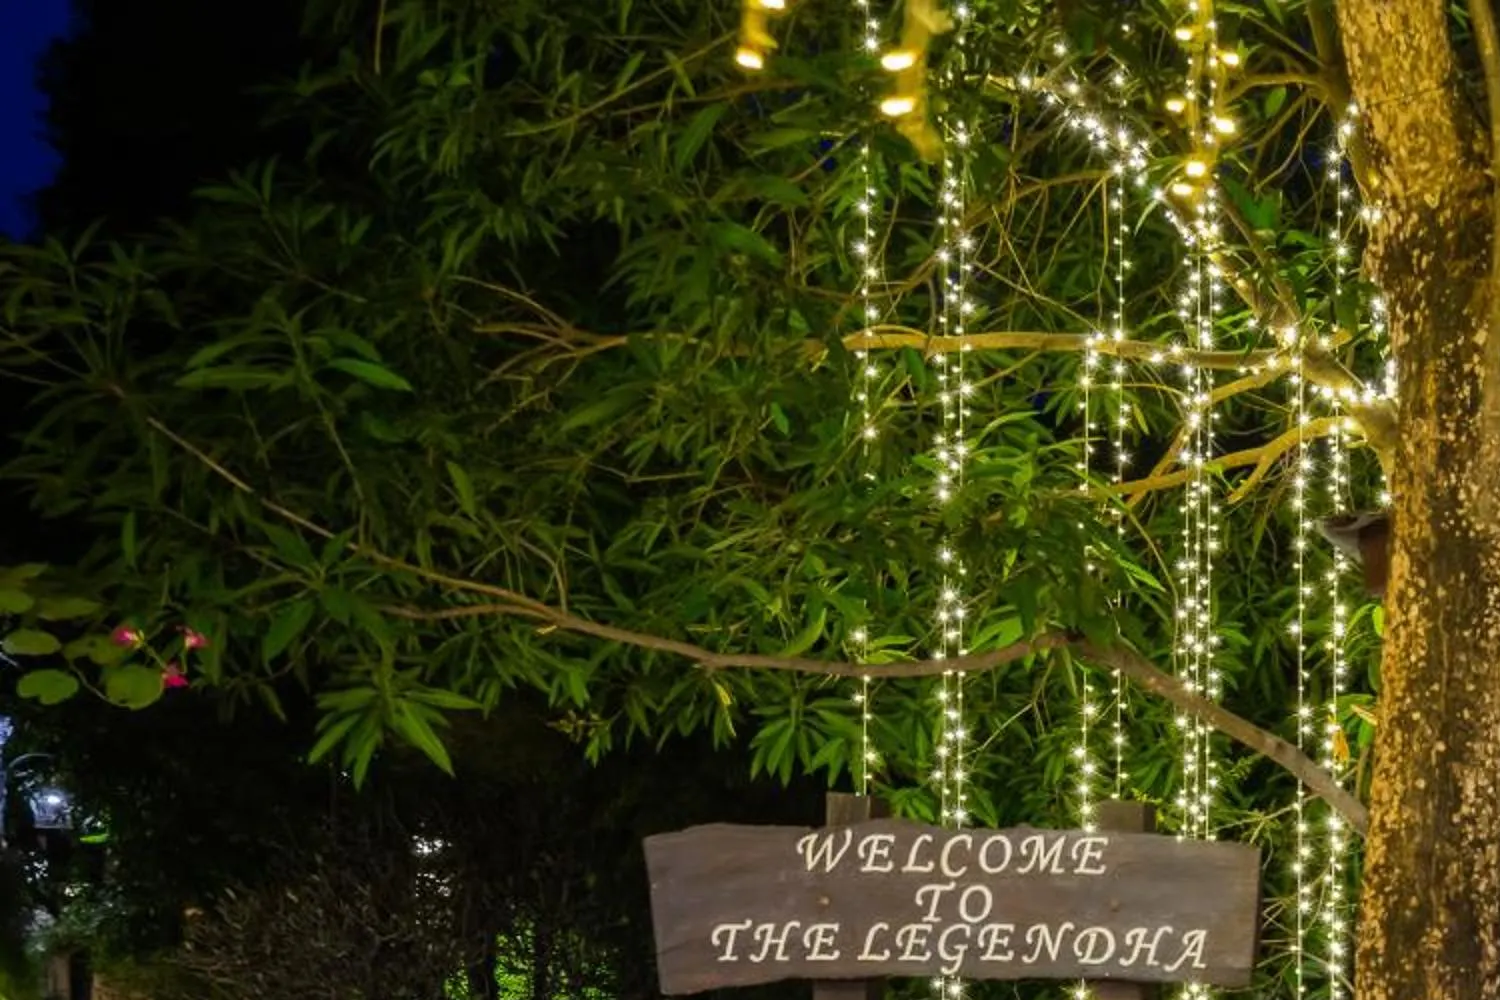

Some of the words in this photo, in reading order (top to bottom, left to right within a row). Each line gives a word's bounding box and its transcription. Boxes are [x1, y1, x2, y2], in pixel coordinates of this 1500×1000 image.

[796, 827, 1109, 878] WELCOME
[914, 883, 993, 922] TO
[711, 919, 841, 963] THE
[857, 921, 1208, 975] LEGENDHA
